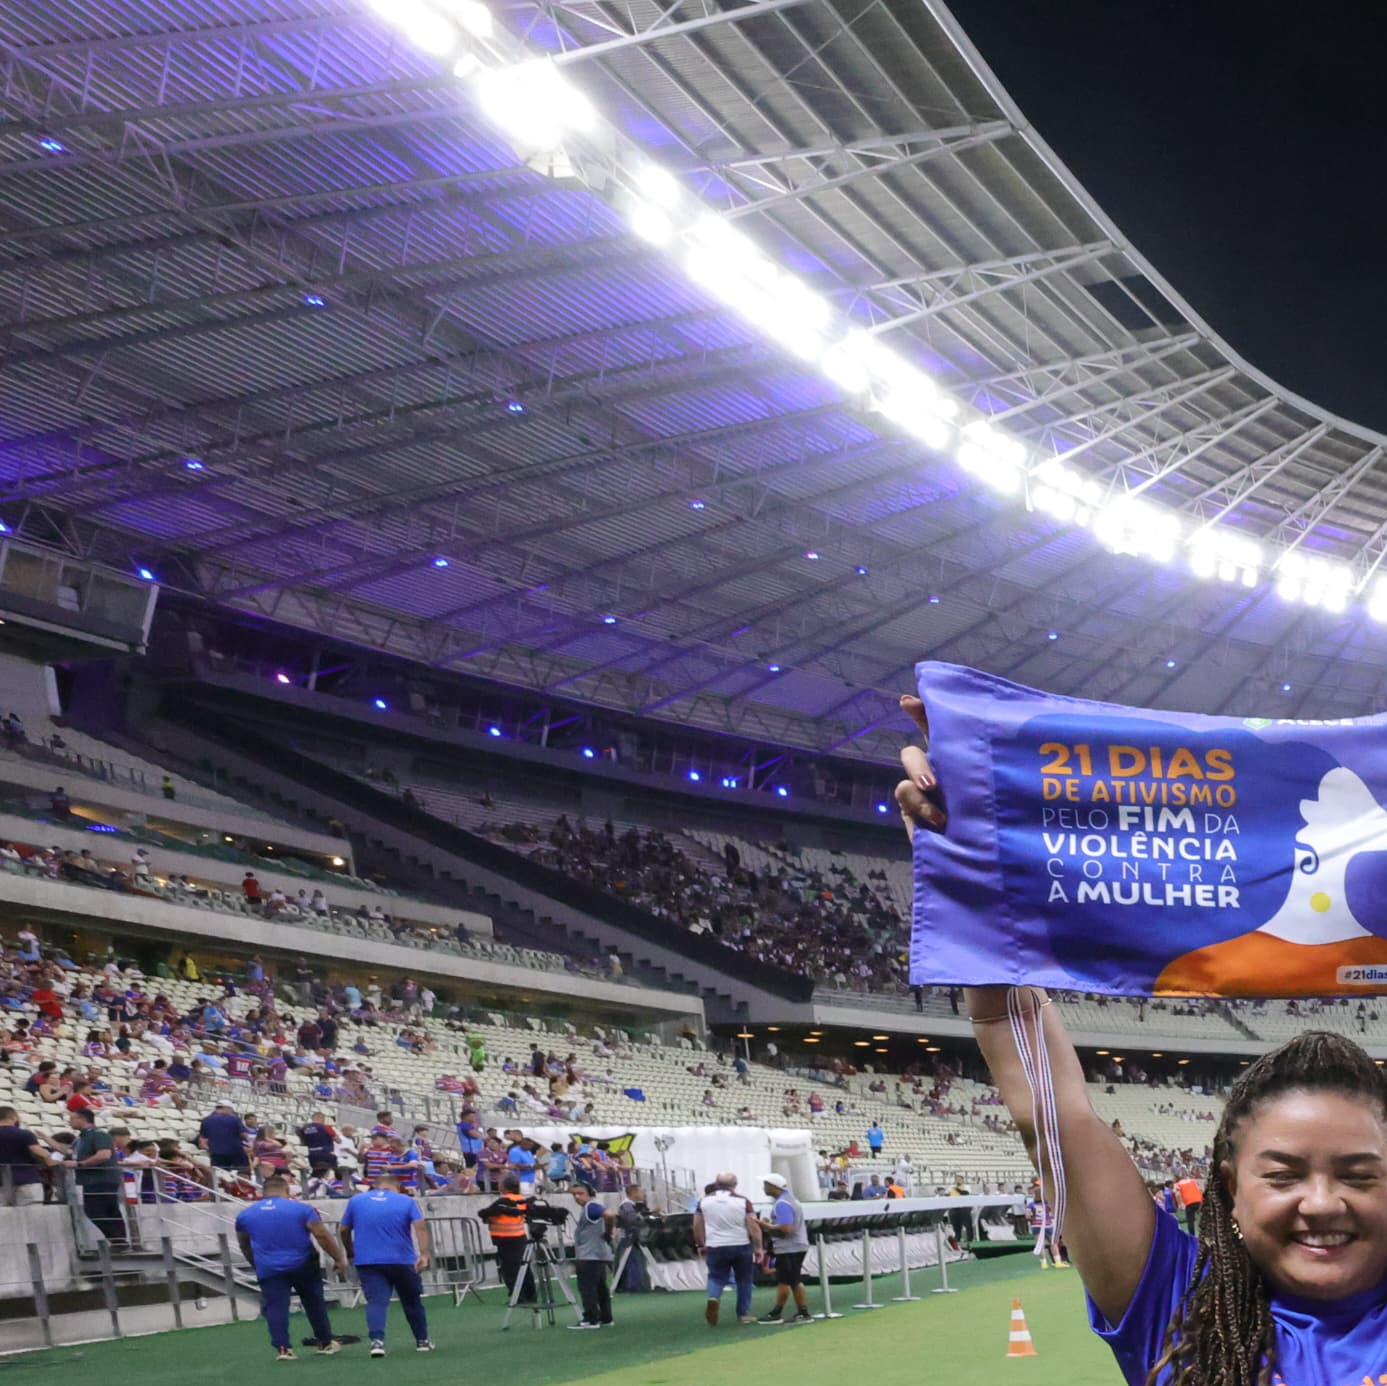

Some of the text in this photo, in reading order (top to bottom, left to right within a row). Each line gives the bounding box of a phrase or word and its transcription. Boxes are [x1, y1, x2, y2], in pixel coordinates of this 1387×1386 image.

[1039, 742, 1235, 781] 21 DIAS
[1042, 778, 1236, 807] DE ATIVISMO
[1042, 805, 1240, 834] PELO FIM DA
[1042, 831, 1237, 861] VIOLÊNCIA
[1047, 858, 1236, 883] CONTRA
[1048, 880, 1240, 908] A MULHER
